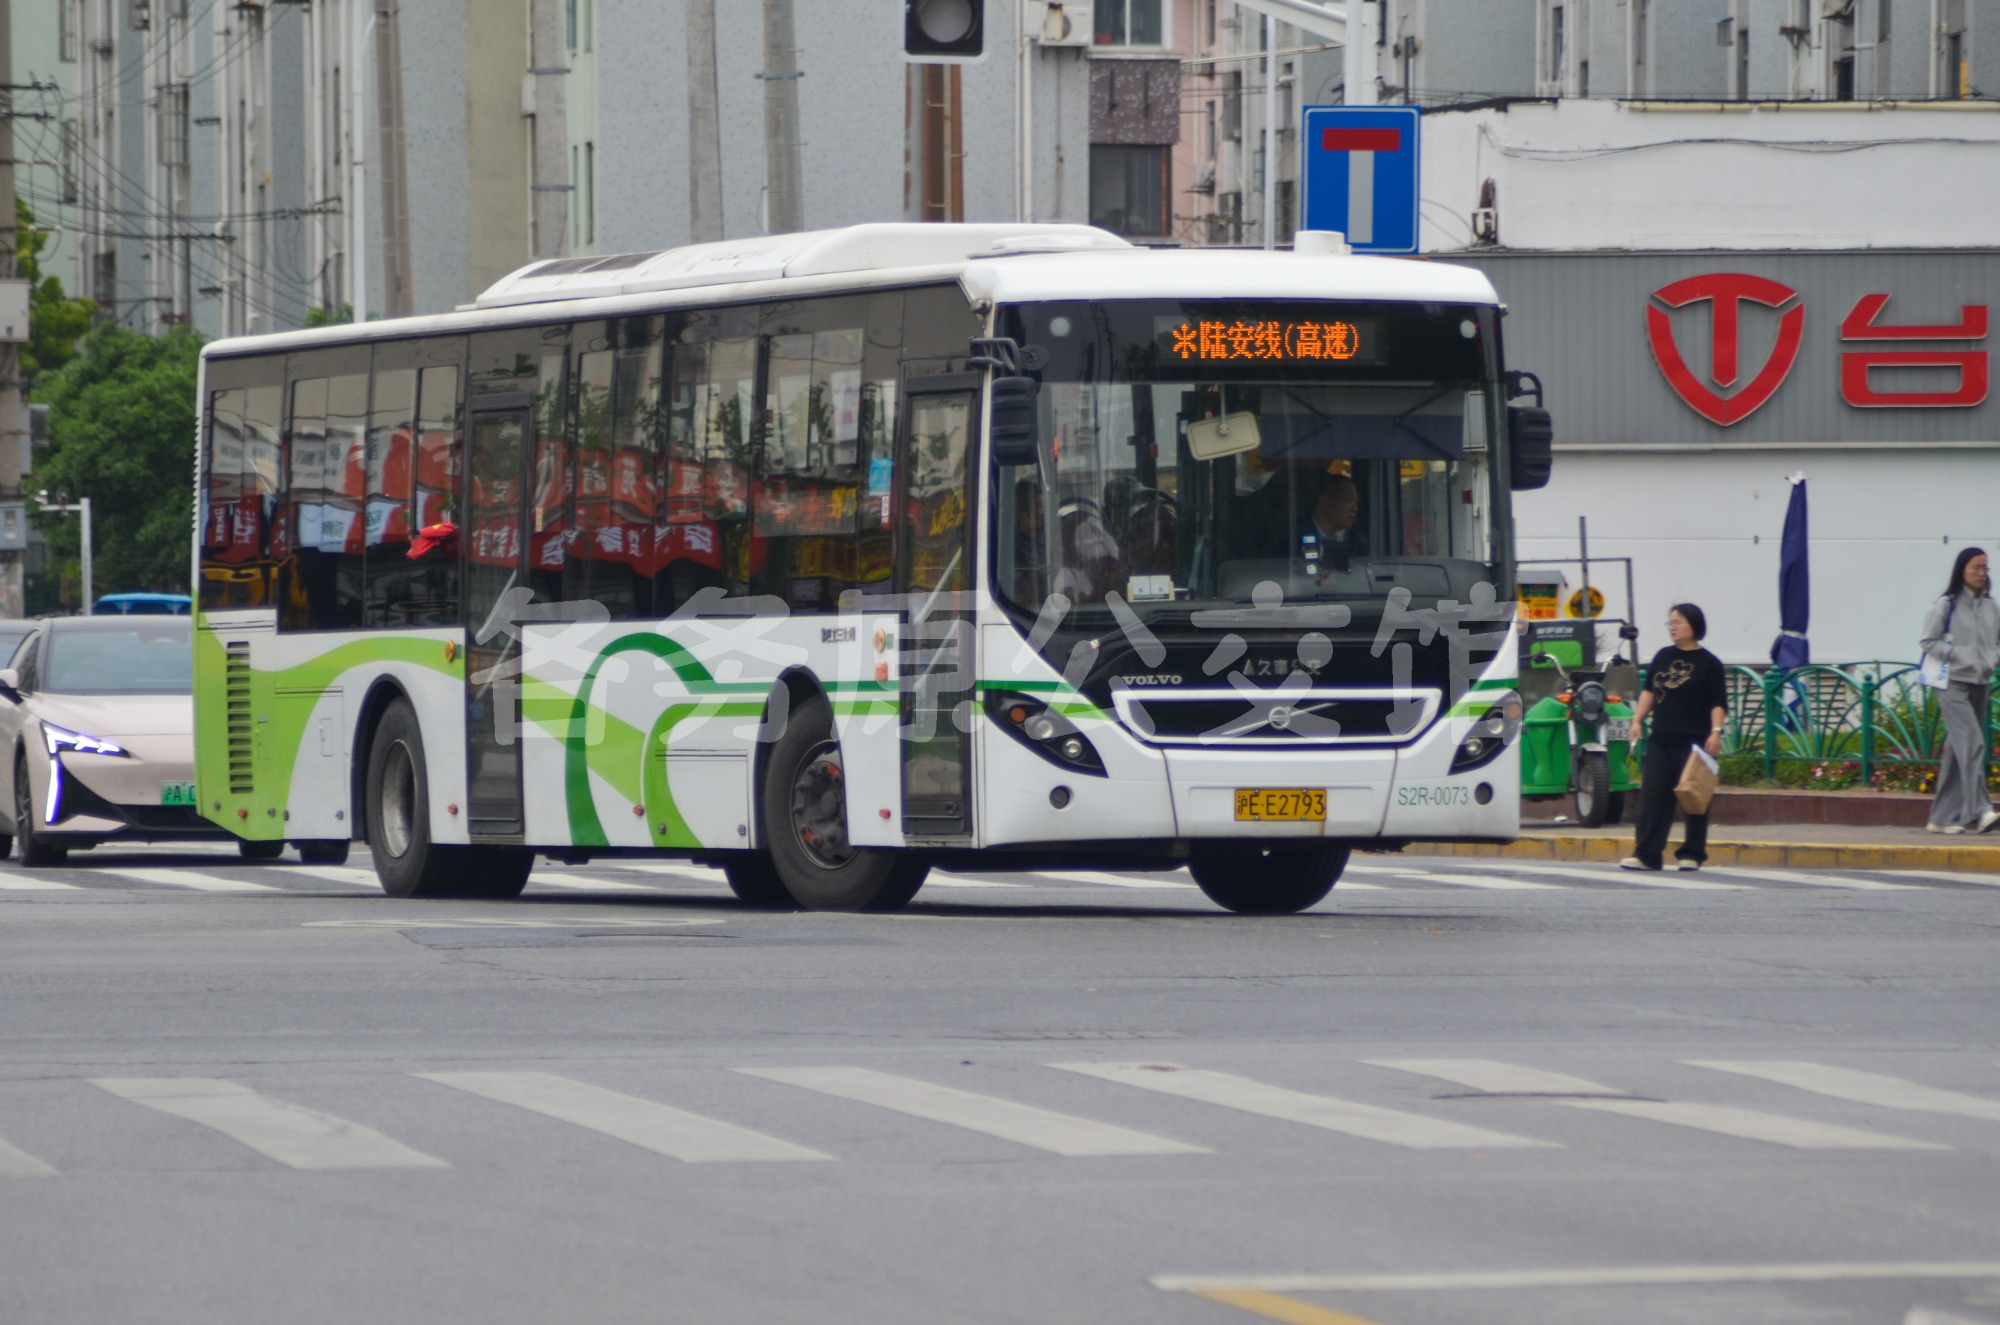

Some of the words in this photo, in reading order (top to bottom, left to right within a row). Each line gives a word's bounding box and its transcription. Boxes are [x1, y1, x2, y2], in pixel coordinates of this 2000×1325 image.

[1839, 293, 1989, 407] 台
[1123, 674, 1183, 686] VOLVO
[1398, 786, 1469, 806] S2R-0073
